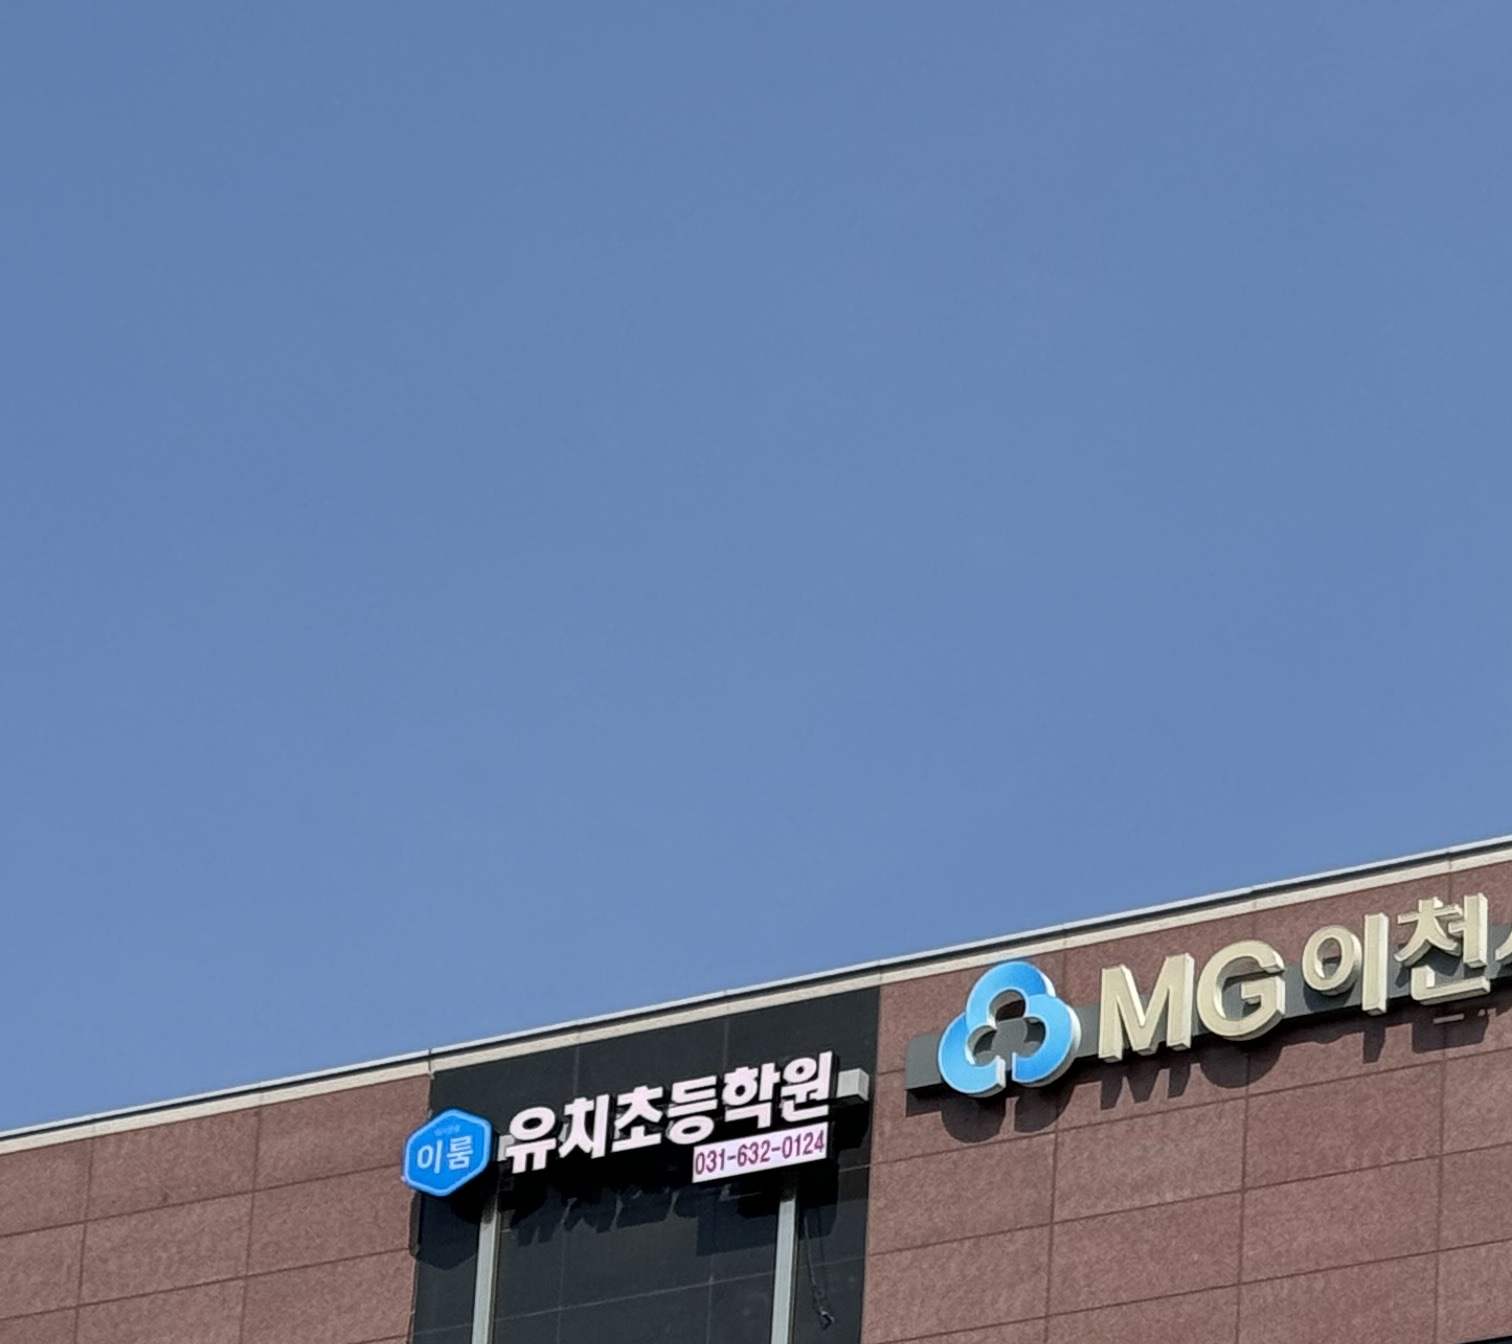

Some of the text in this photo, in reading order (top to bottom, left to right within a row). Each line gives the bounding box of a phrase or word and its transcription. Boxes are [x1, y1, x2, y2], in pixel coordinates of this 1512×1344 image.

[506, 1052, 833, 1173] 유치초등학원
[416, 1135, 474, 1175] 이룸
[694, 1131, 825, 1176] 031-632-0124
